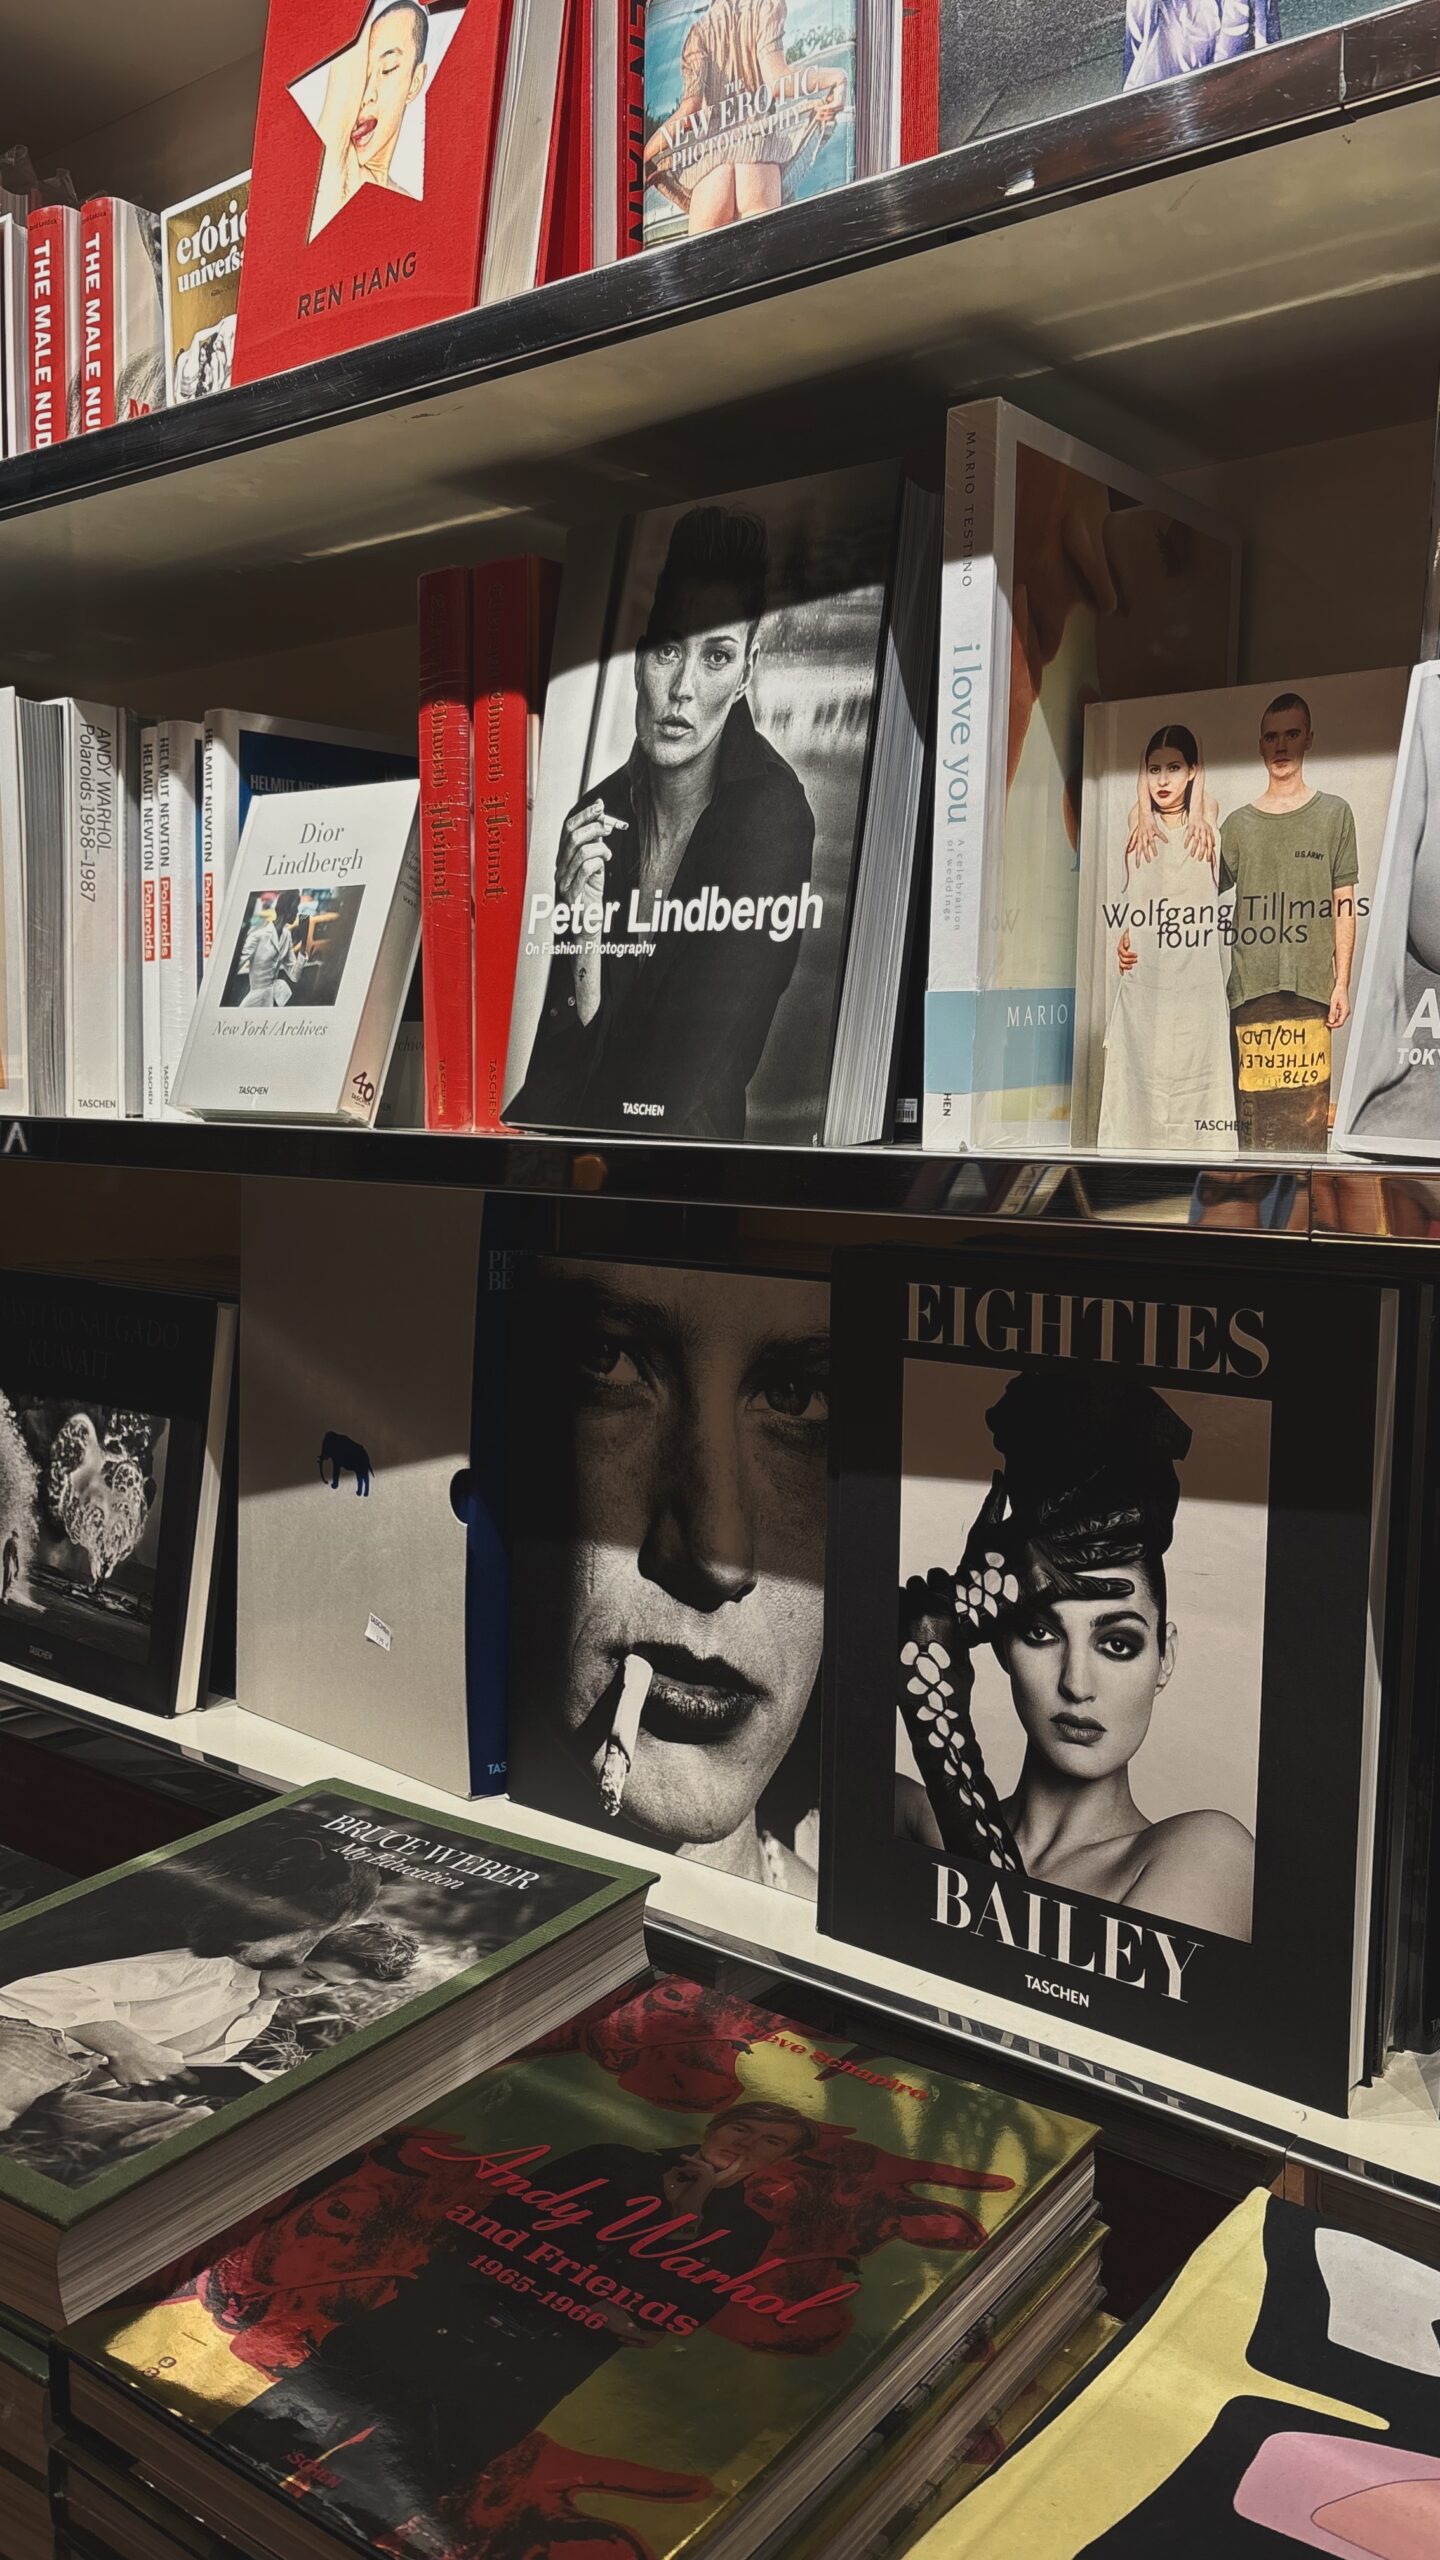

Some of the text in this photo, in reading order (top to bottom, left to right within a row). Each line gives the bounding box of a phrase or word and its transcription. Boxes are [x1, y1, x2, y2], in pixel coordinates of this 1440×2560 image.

[659, 64, 820, 153] NEW EROTIC
[671, 107, 802, 172] PHOTOGRAPHY
[34, 240, 51, 300] THE
[85, 232, 101, 297] THE
[177, 245, 244, 292] univers
[297, 251, 418, 320] REN HANG
[34, 305, 52, 386] MALE
[86, 298, 101, 382] MALE
[86, 386, 101, 433] NU
[962, 431, 977, 588] MARIO TESTINO
[79, 722, 96, 801] Polaroids
[943, 643, 983, 825] i love you
[96, 727, 113, 853] ANDY WARHOL
[143, 743, 155, 961] HELMUT NEWTON Polaroids
[160, 737, 171, 960] HELMUT NEWTON Polaroids
[299, 821, 345, 845] Dior
[264, 851, 364, 881] Lindbergh
[943, 858, 954, 921] weddings
[954, 853, 964, 931] celebration
[527, 882, 824, 942] Peter Lindbergh
[1102, 892, 1370, 933] Wolfgang Tillmans
[1156, 919, 1309, 949] four books
[525, 940, 656, 958] On Fashion Photography
[212, 1020, 240, 1036] New
[1006, 1003, 1068, 1028] MARIO
[1240, 1052, 1326, 1069] WITHERLEY
[1397, 1047, 1440, 1066] TOK
[78, 1098, 117, 1109] TASCHEN
[238, 1086, 269, 1096] TASCHEN
[489, 1059, 497, 1118] TASCHEN
[623, 1102, 665, 1117] TASCHEN
[902, 1282, 1271, 1379] EIGHTIES
[320, 1814, 541, 1890] BRUCE WEBER
[331, 1842, 465, 1890] My Education
[930, 1862, 1205, 2004] BAILEY
[1024, 1973, 1090, 2009] TASCHEN
[809, 2049, 929, 2101] Schapiro
[420, 2144, 862, 2325] Andy Warhol
[445, 2204, 700, 2338] and Friends
